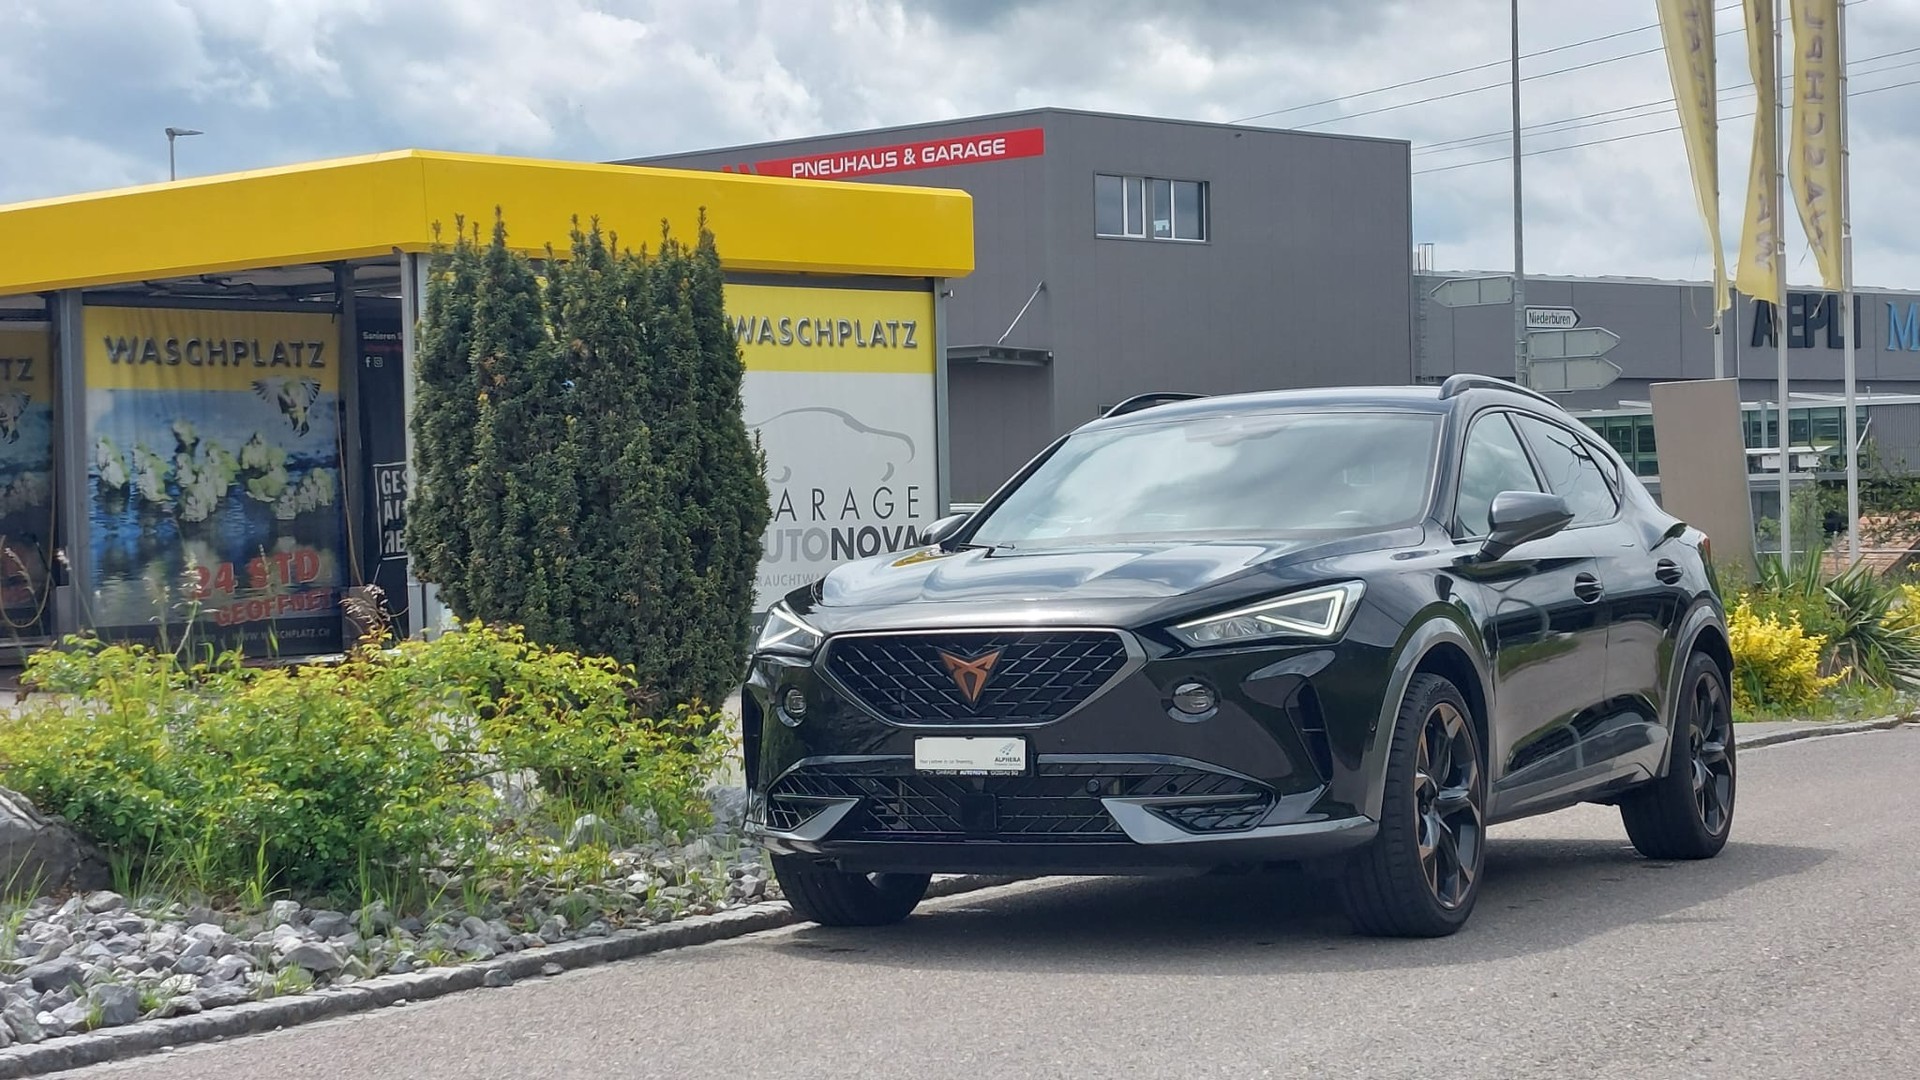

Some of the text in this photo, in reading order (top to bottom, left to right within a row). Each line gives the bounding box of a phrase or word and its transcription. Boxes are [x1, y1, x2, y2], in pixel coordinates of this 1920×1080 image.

[792, 138, 1006, 178] PNEUHAUS & GARAGE
[362, 331, 397, 340] Sanieren
[726, 314, 918, 348] WASCHPLATZ
[1528, 311, 1571, 325] Niederbüren
[104, 335, 326, 369] WASCHPLATZ
[774, 486, 919, 522] ARAGE
[763, 525, 920, 563] UTONOVA
[246, 548, 321, 589] STD
